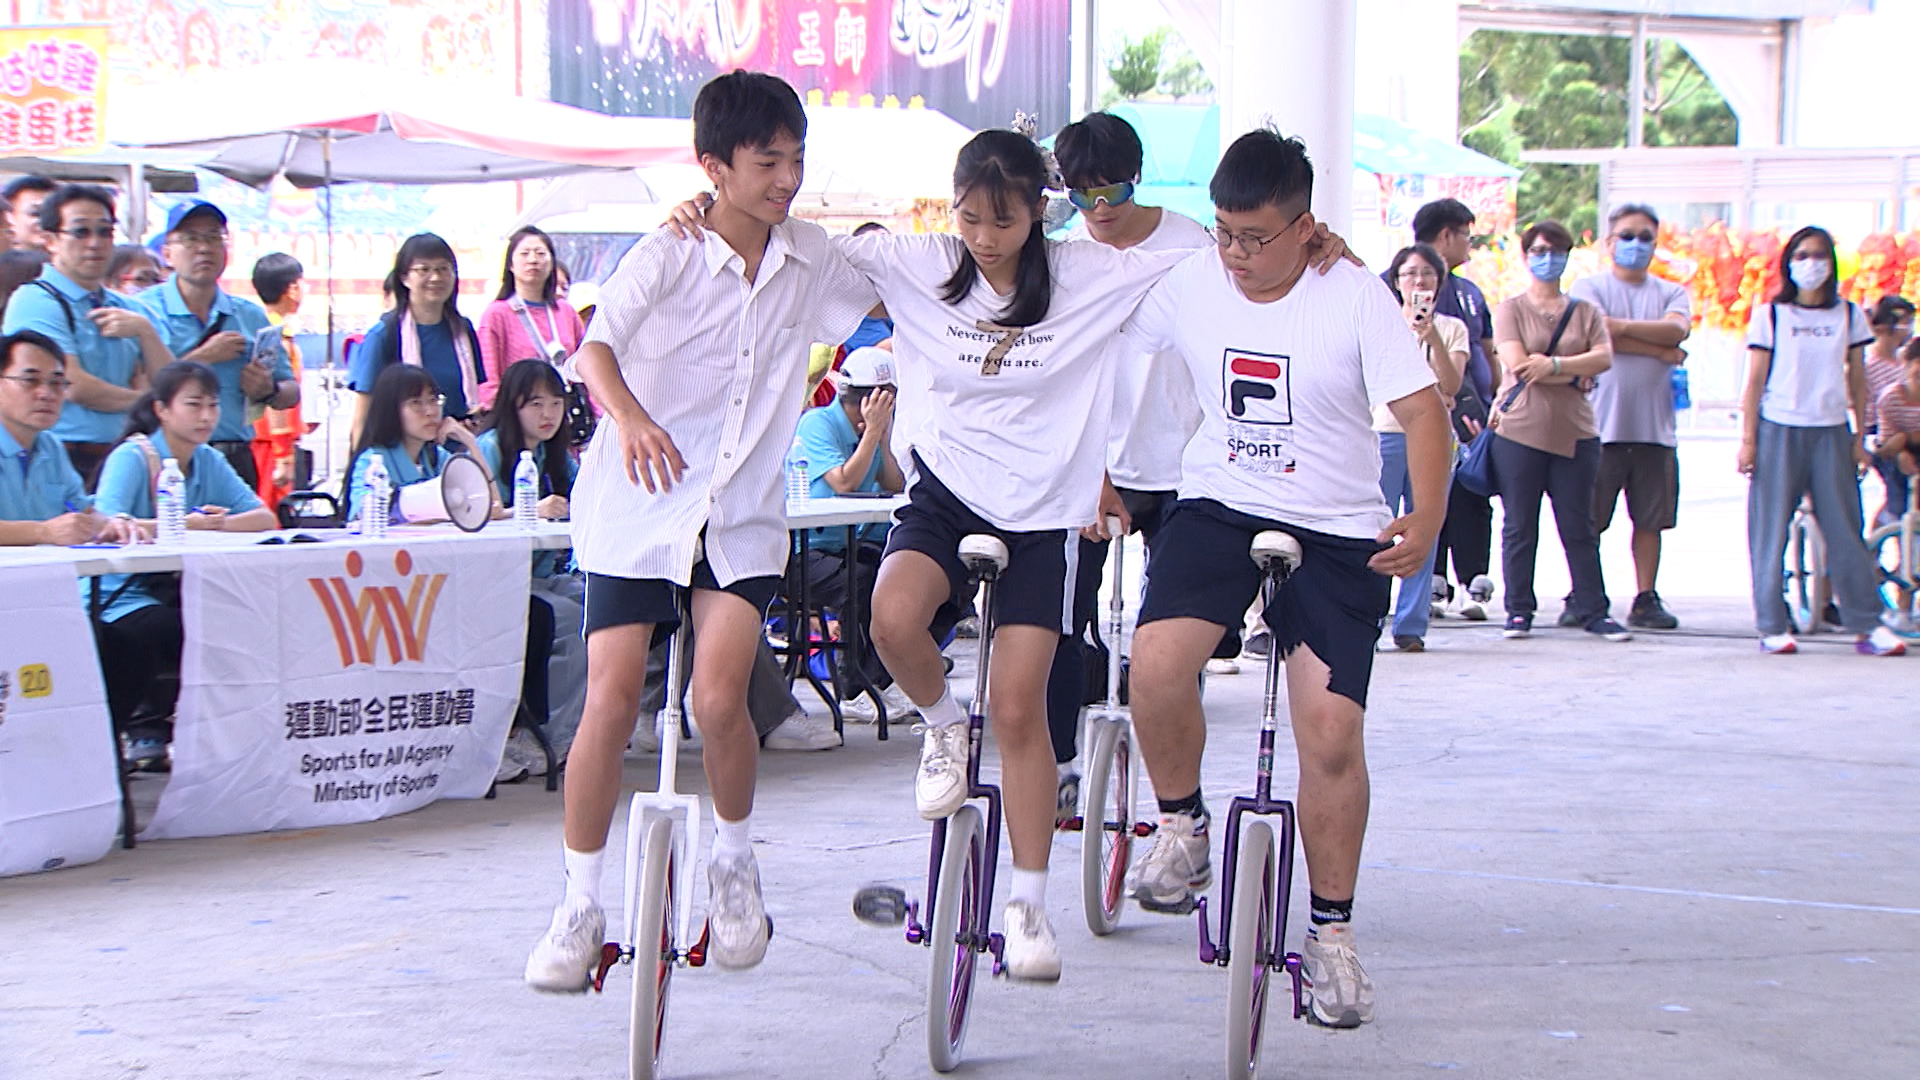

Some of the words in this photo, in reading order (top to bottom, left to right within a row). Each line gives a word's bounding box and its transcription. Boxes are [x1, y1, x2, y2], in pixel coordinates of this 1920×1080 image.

[946, 325, 985, 341] Never
[958, 352, 982, 363] are
[1227, 438, 1282, 458] SPORT
[284, 688, 475, 740] 運動部全民運動署
[301, 753, 357, 777] Sports
[359, 747, 383, 769] for
[384, 746, 404, 767] All
[405, 744, 454, 767] Agency
[314, 780, 383, 803] Ministry
[384, 774, 399, 796] of
[399, 772, 439, 796] Sports
